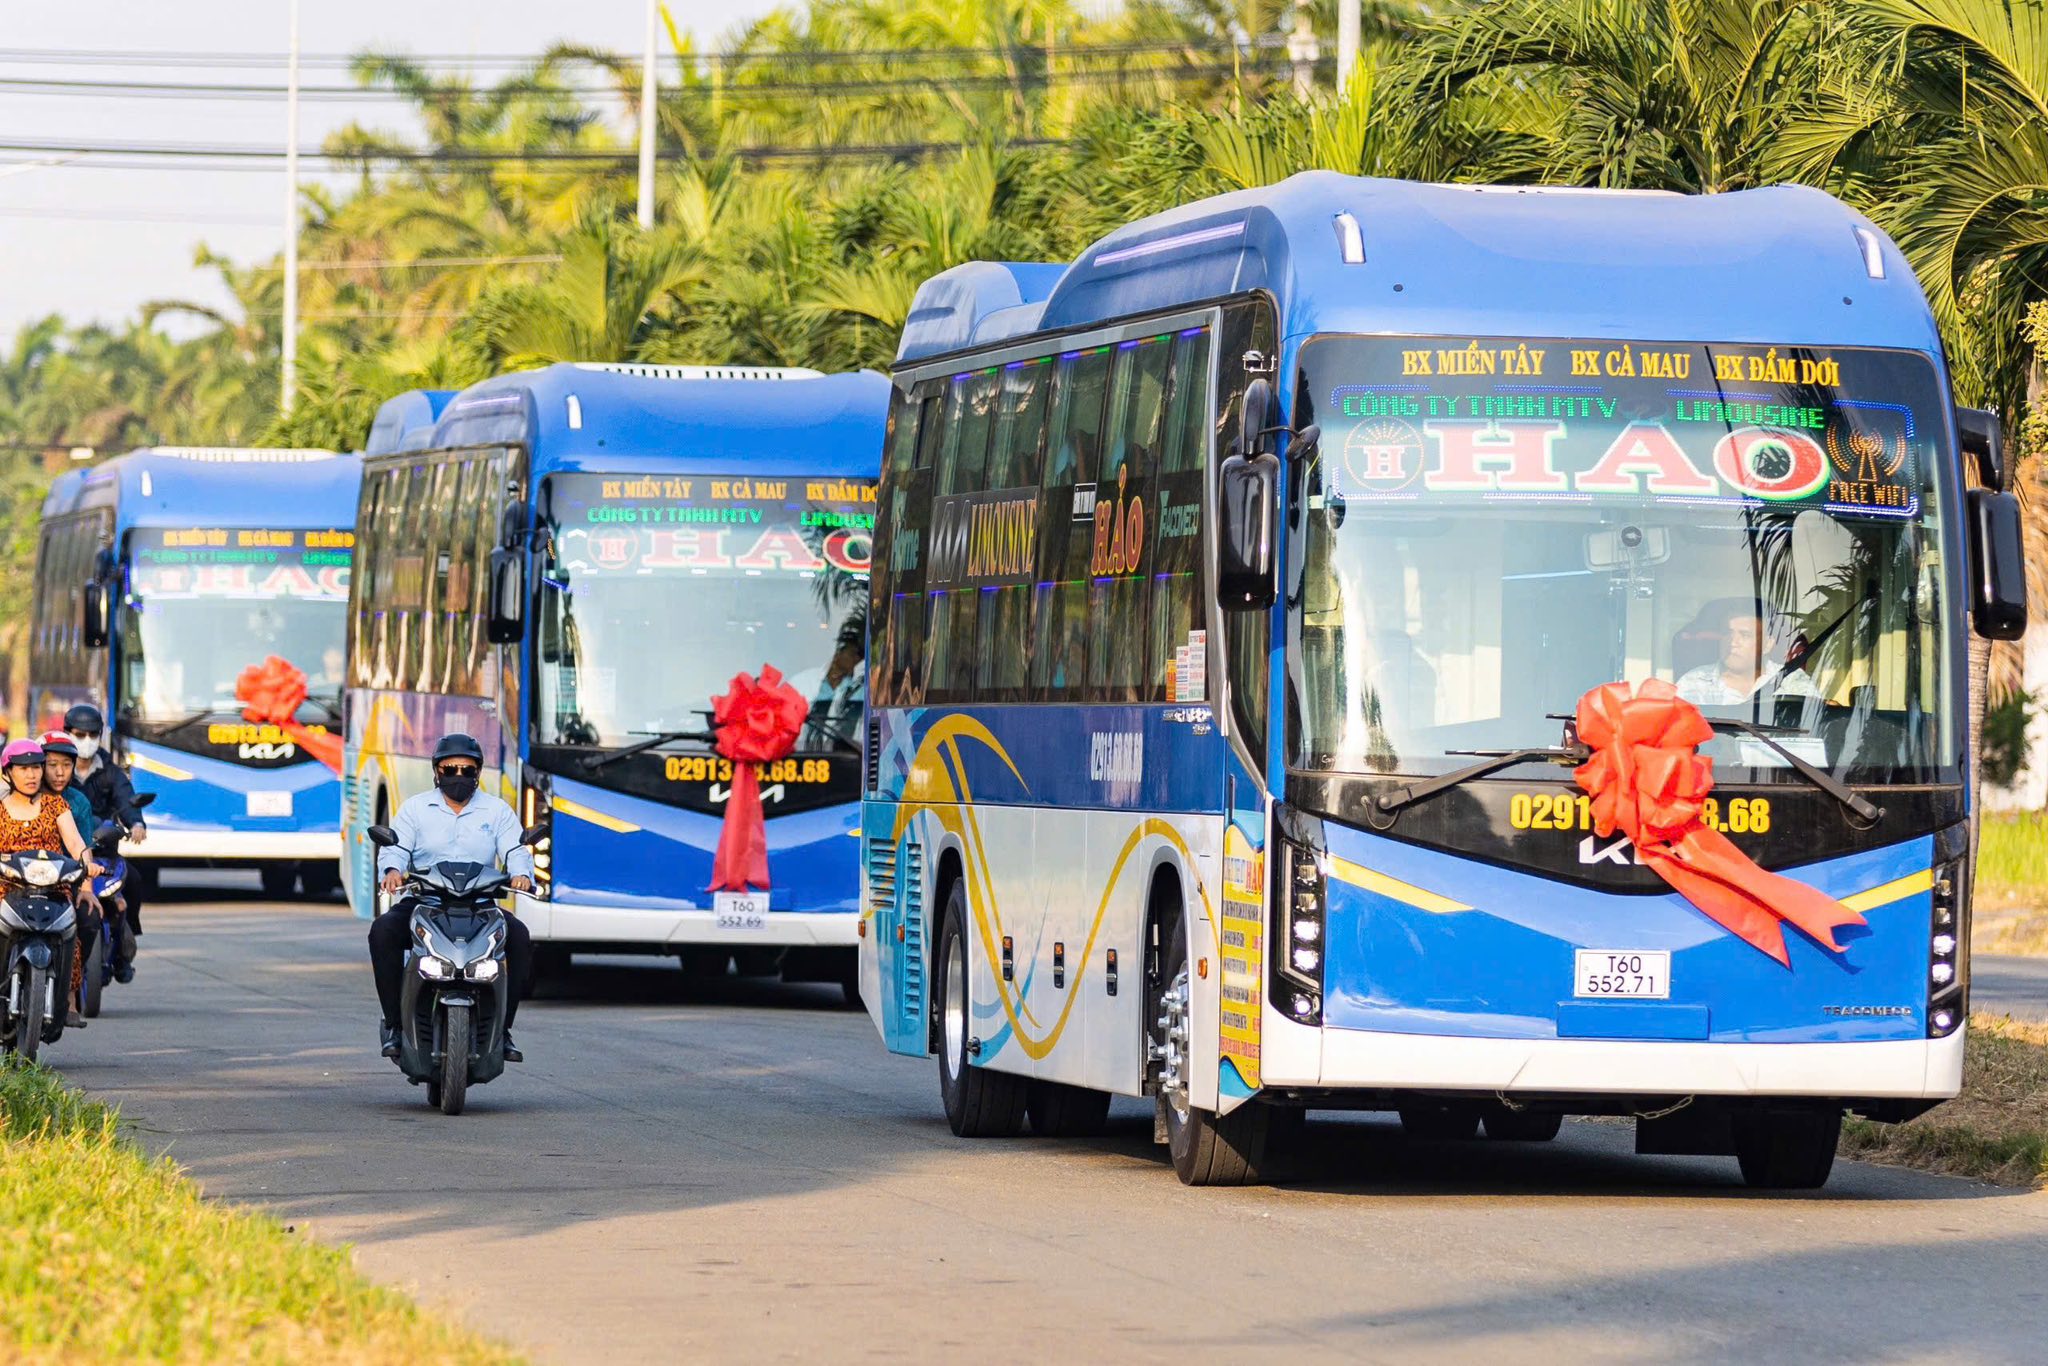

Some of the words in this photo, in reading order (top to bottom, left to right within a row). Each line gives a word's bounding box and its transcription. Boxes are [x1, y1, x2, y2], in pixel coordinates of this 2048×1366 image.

[1402, 350, 1432, 376] BX
[1501, 343, 1546, 375] TÂY
[1571, 350, 1600, 376] BX
[1605, 343, 1636, 377] CÀ
[1641, 352, 1691, 379] MAU
[1715, 354, 1745, 381] BX
[1343, 390, 1419, 416] CÔNG
[1424, 395, 1460, 416] TY
[1552, 396, 1617, 418] MTV
[1675, 400, 1825, 429] LIMOUSINE
[1363, 444, 1406, 480] H
[1423, 417, 1831, 500] HAO
[602, 481, 621, 499] BX
[711, 481, 730, 499] BX
[755, 482, 787, 500] MAU
[806, 482, 825, 501] BX
[1829, 479, 1869, 504] FREE
[1873, 483, 1909, 507] WIFI
[639, 506, 664, 522] TY
[1091, 463, 1144, 576] HẢO
[641, 526, 872, 573] HAO
[967, 498, 1037, 577] LIMOUSINE
[733, 900, 755, 912] T60
[1608, 955, 1642, 974] T60
[1587, 975, 1655, 994] 552.71
